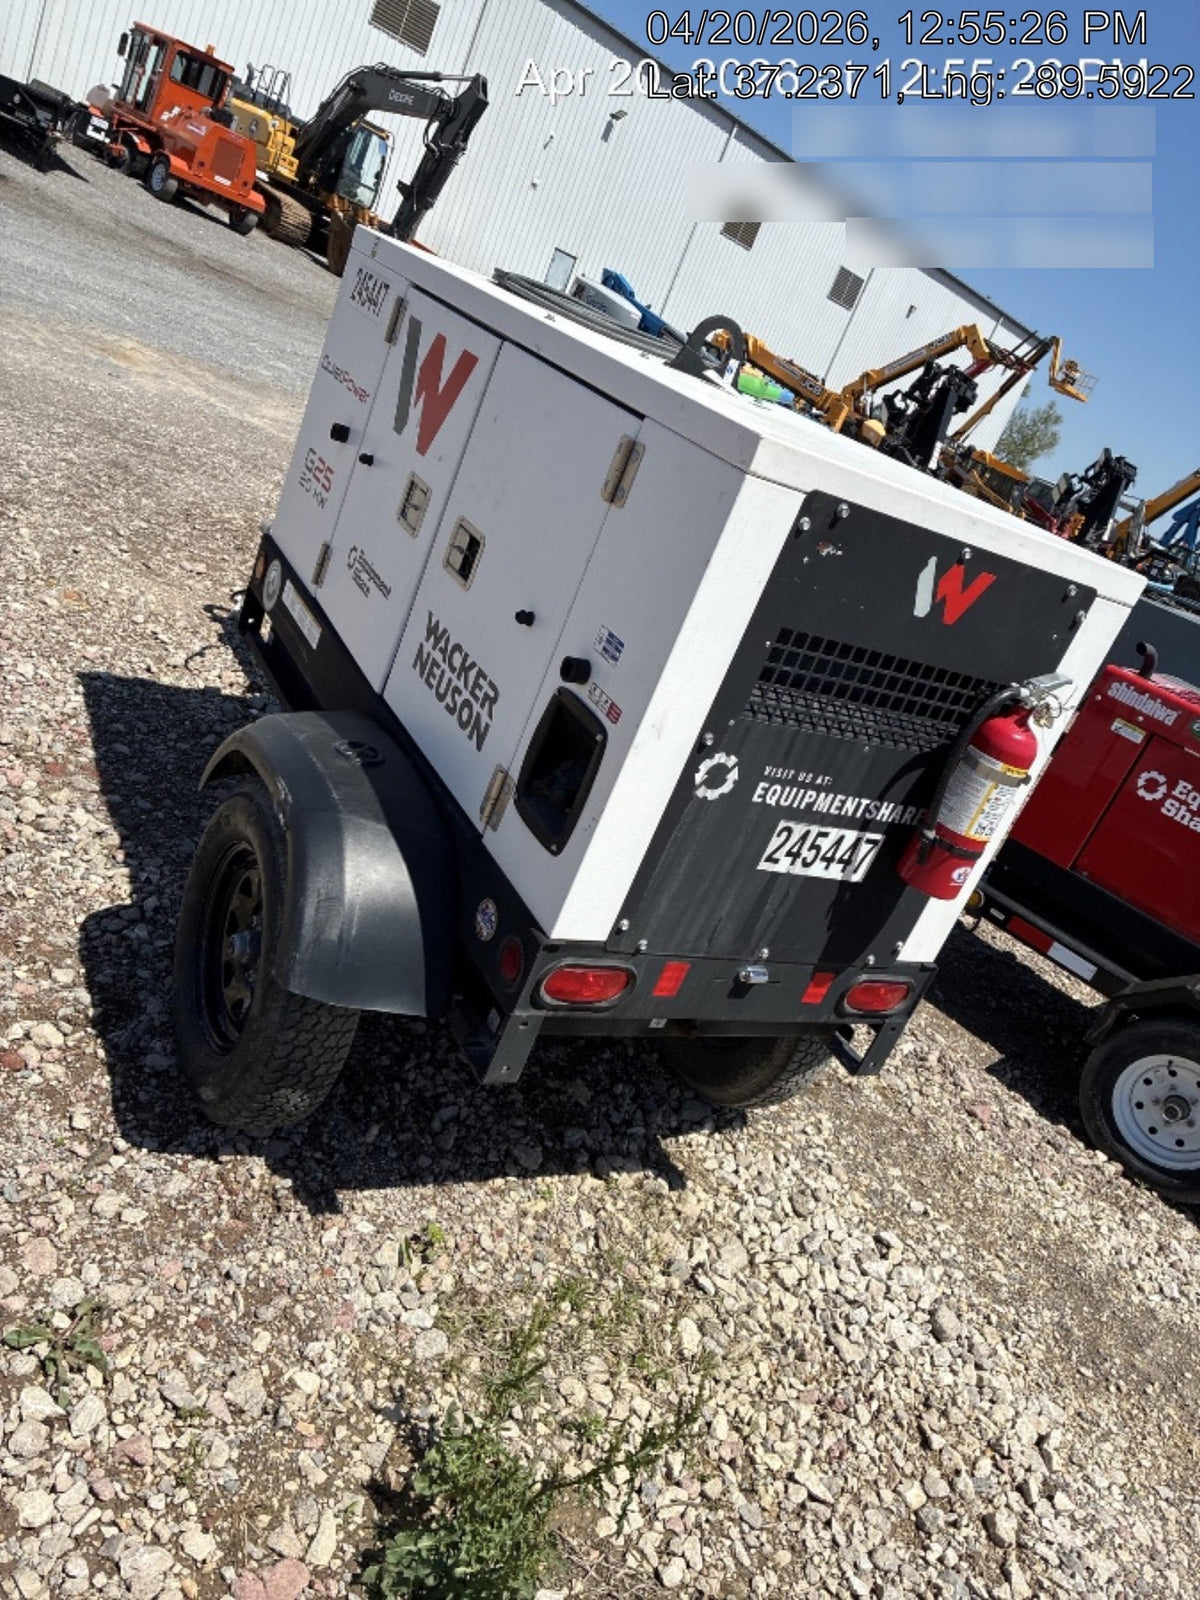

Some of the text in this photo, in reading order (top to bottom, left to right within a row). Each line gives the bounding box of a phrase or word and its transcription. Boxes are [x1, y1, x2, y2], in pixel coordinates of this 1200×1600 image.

[351, 267, 390, 318] 245447
[425, 610, 500, 721] WACKER
[412, 642, 490, 752] NEUSON
[1107, 681, 1178, 727] shindaiwa
[763, 765, 834, 787] VISIT US AT:
[763, 825, 881, 876] 245447
